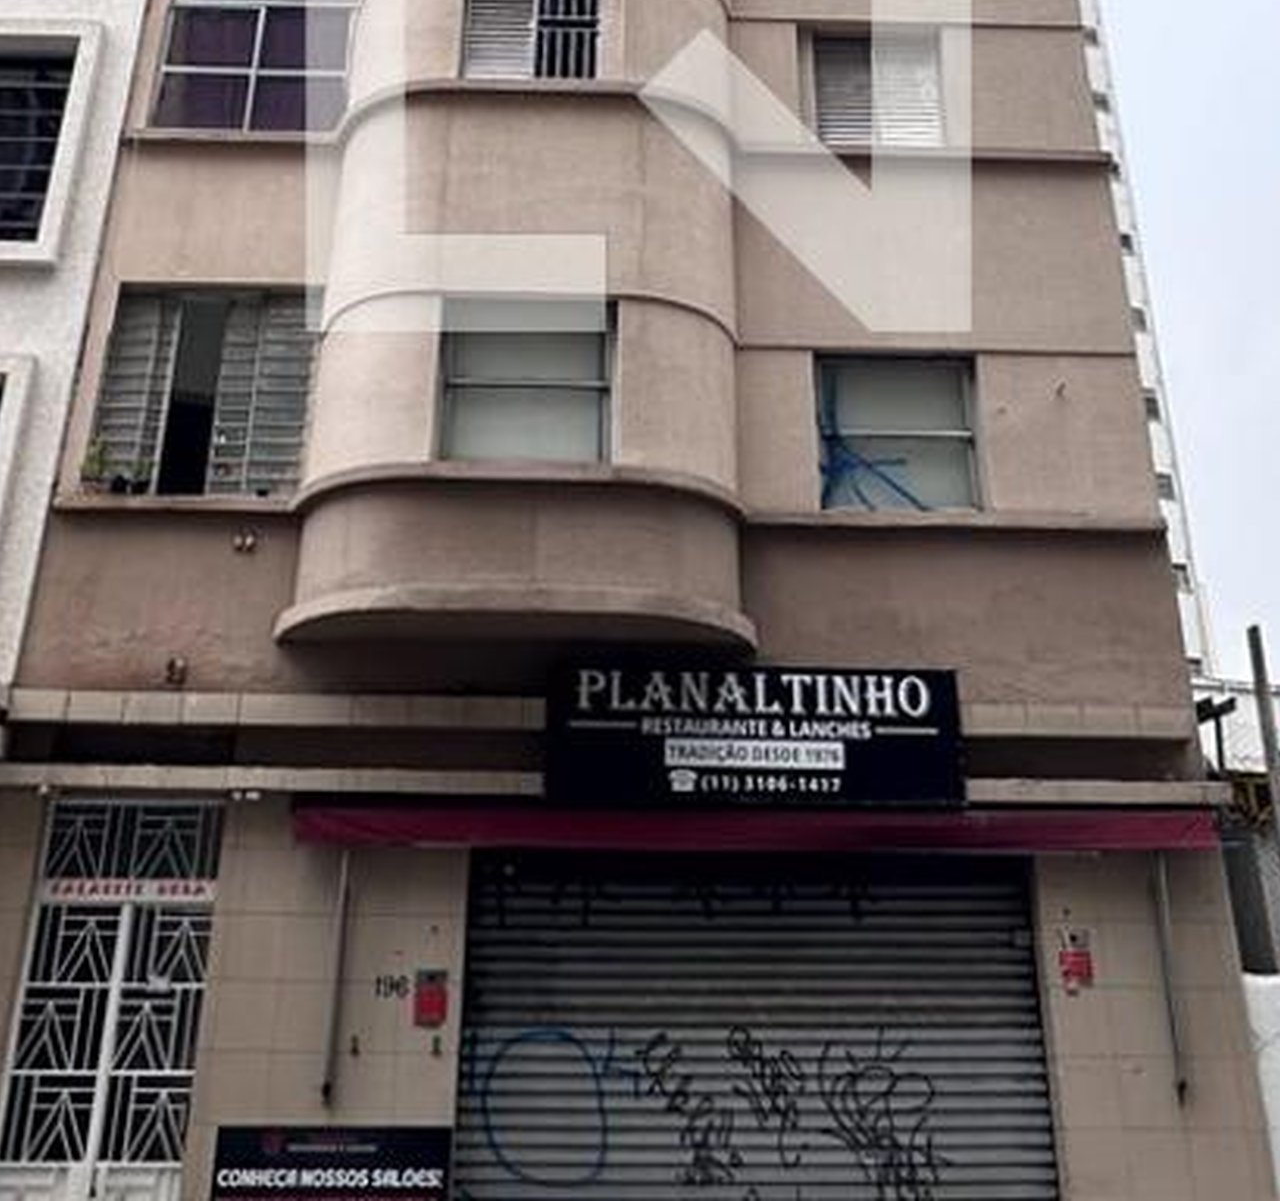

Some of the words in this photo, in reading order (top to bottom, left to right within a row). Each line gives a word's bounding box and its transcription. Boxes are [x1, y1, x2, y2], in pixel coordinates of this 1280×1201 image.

[575, 670, 930, 717] PLANALTINHO
[641, 716, 766, 736] RESTAURANTE
[771, 720, 786, 737] &
[788, 720, 871, 740] LANCHES
[753, 747, 800, 764] DESDE
[701, 774, 740, 793] (11)
[301, 1168, 369, 1189] NOSSOS
